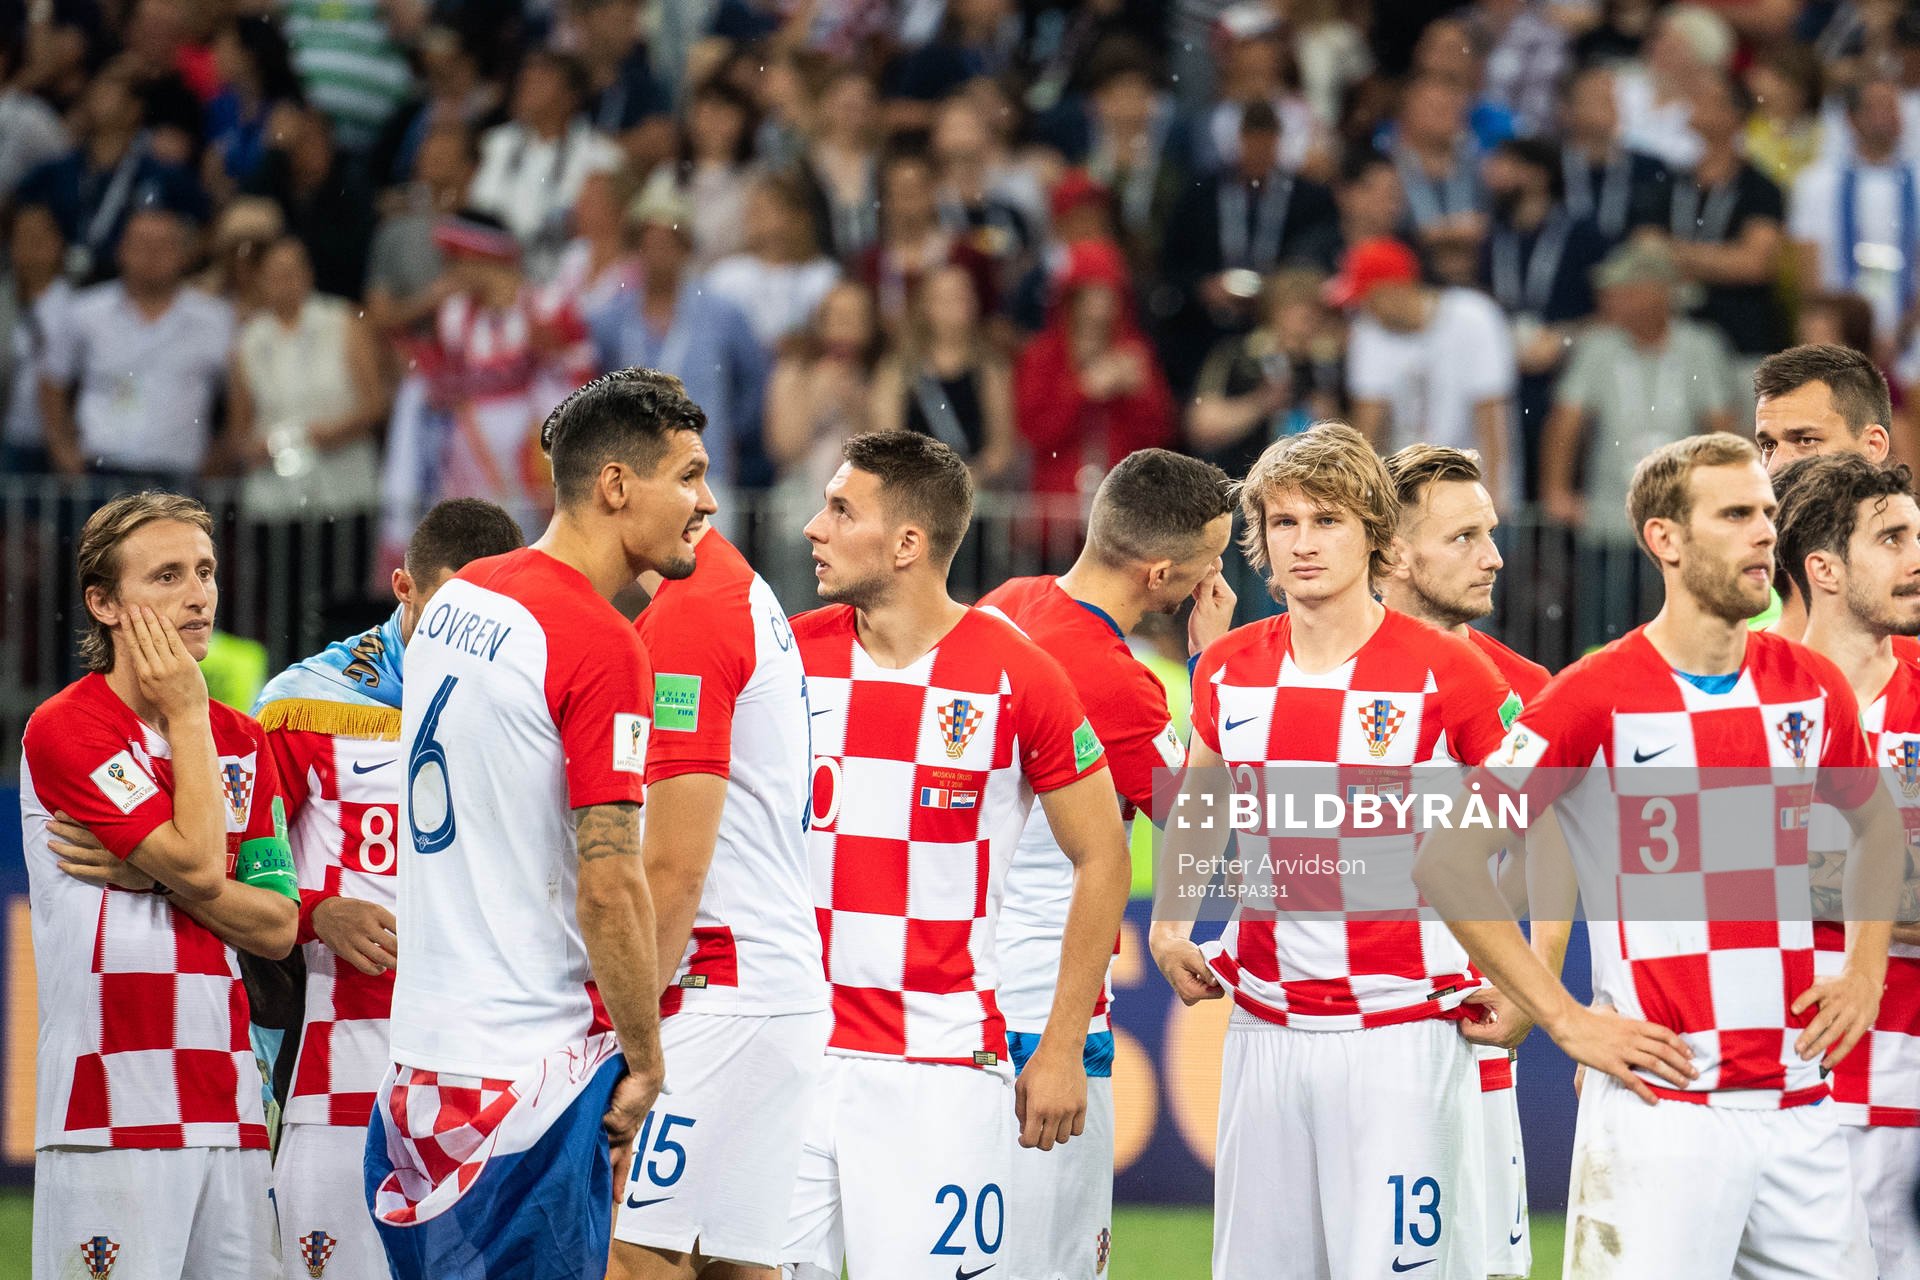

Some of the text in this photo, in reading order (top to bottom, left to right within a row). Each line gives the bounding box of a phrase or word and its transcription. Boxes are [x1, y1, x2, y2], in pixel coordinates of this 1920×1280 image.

[417, 602, 512, 662] LOVREN
[408, 673, 460, 855] 6
[811, 755, 843, 829] 0
[242, 848, 292, 864] LIVIN
[358, 806, 395, 873] 8
[1638, 796, 1680, 874] 3
[630, 1110, 697, 1188] 15
[929, 1182, 1005, 1256] 20
[1386, 1173, 1442, 1248] 13
